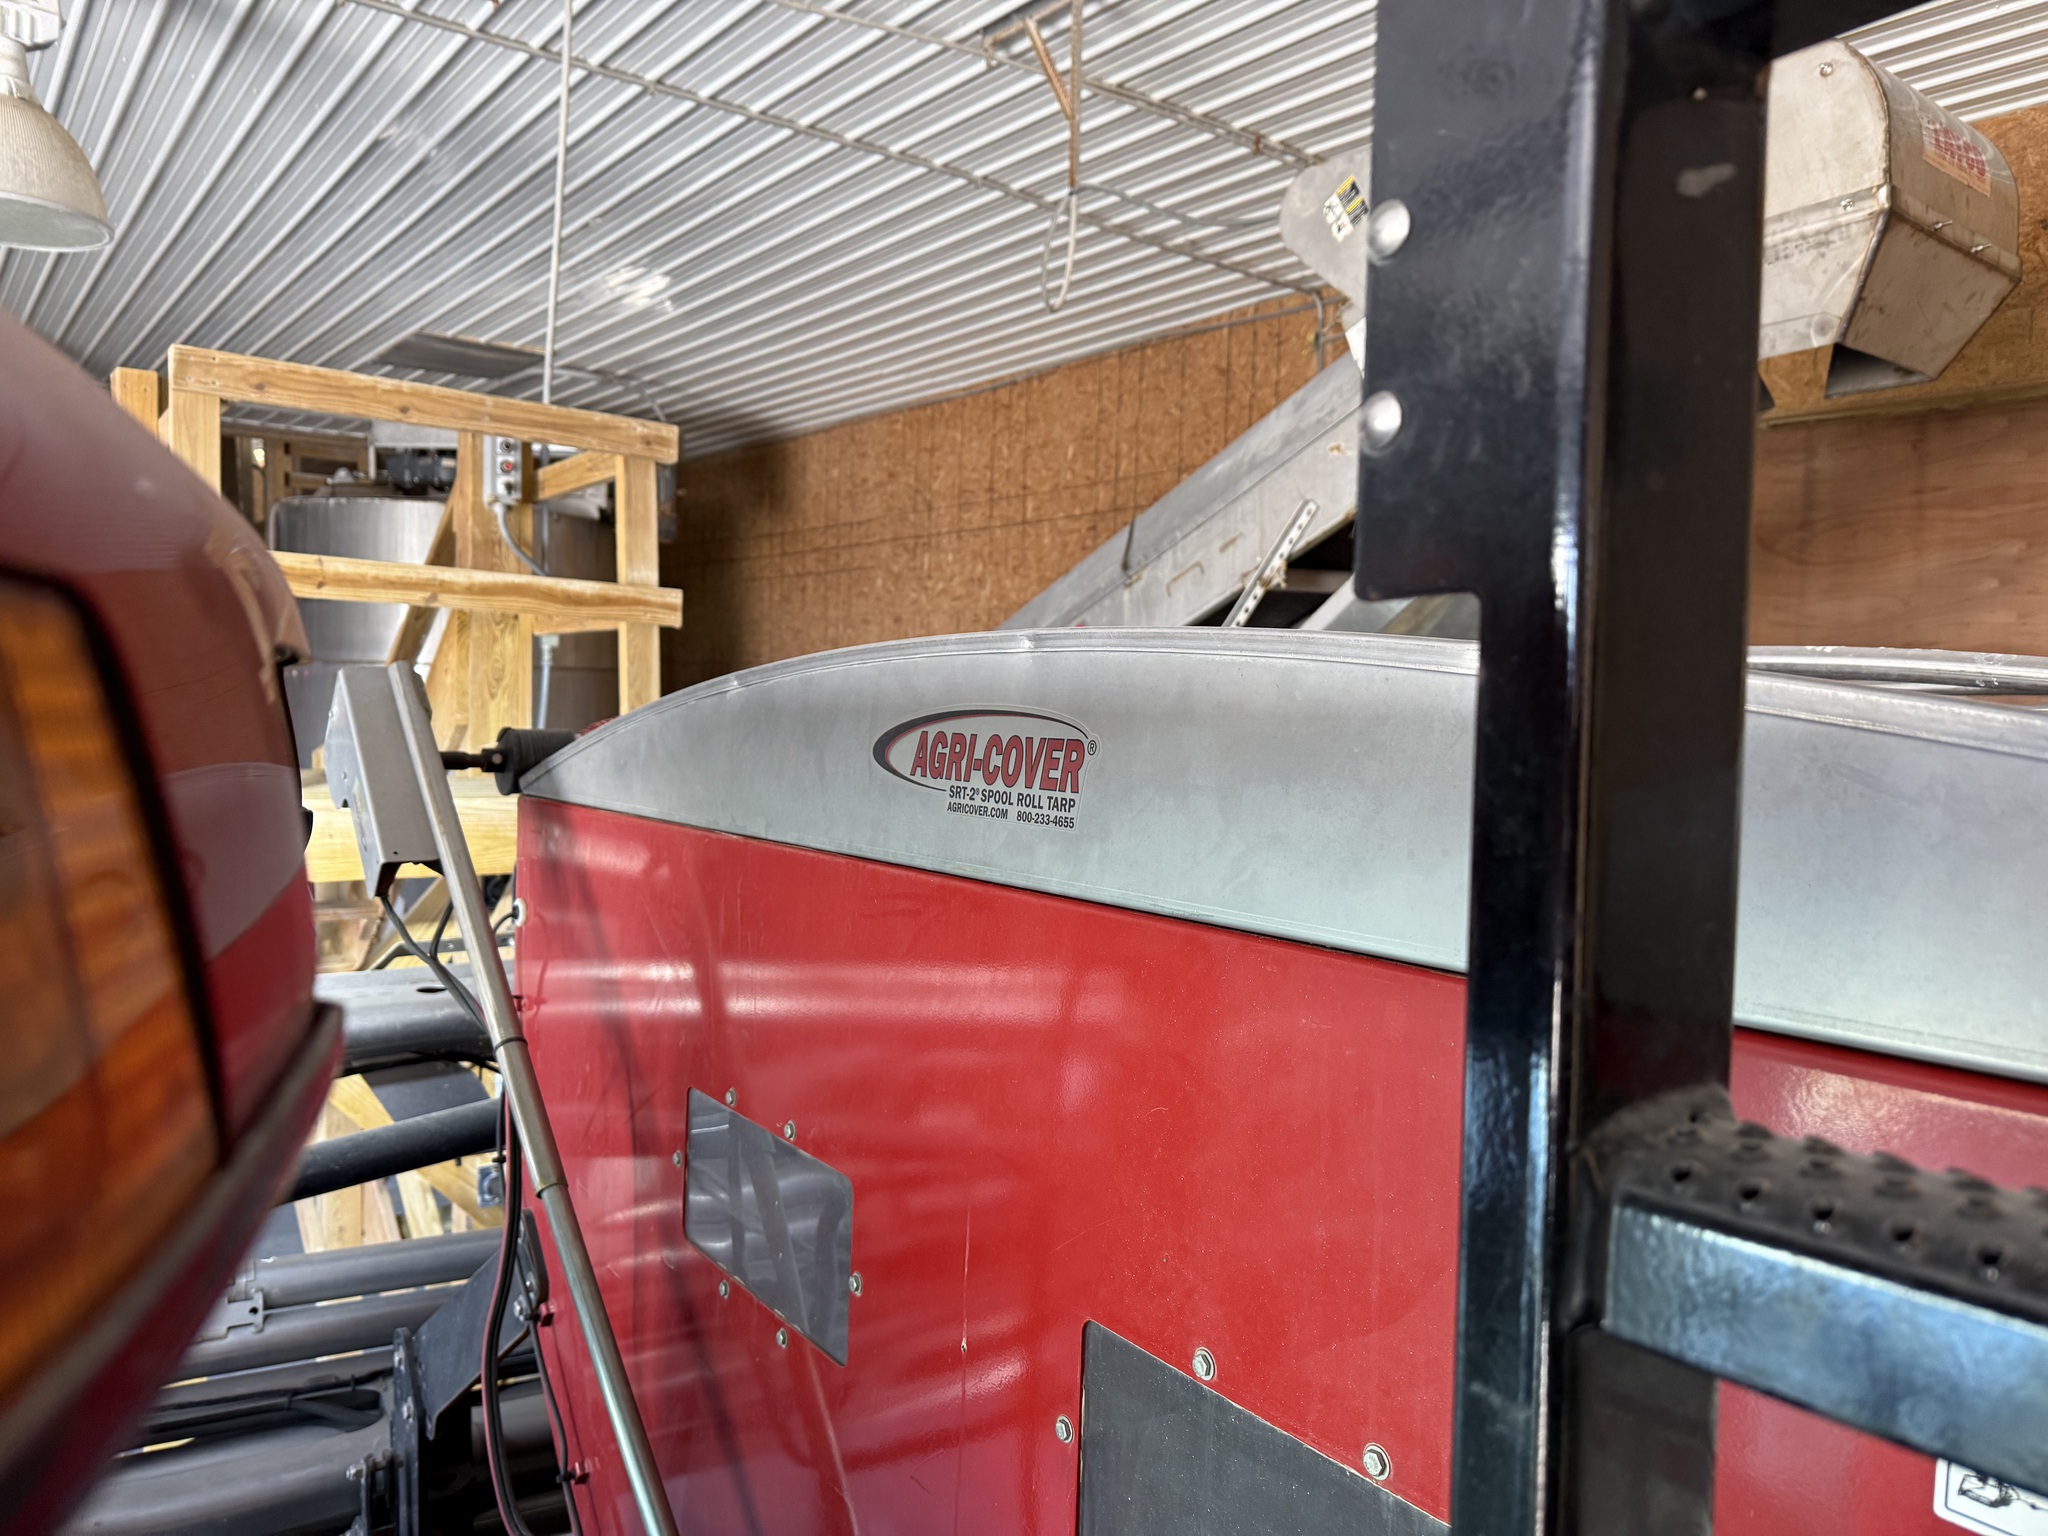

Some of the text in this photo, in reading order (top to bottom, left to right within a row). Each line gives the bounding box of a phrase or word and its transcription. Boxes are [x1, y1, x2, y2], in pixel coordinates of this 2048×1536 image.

[981, 789, 1013, 806] SPOOL
[1017, 792, 1044, 810] ROLL
[1046, 795, 1076, 814] TARP
[946, 802, 1075, 829] AGRICOVER.COM 800-233-4655
